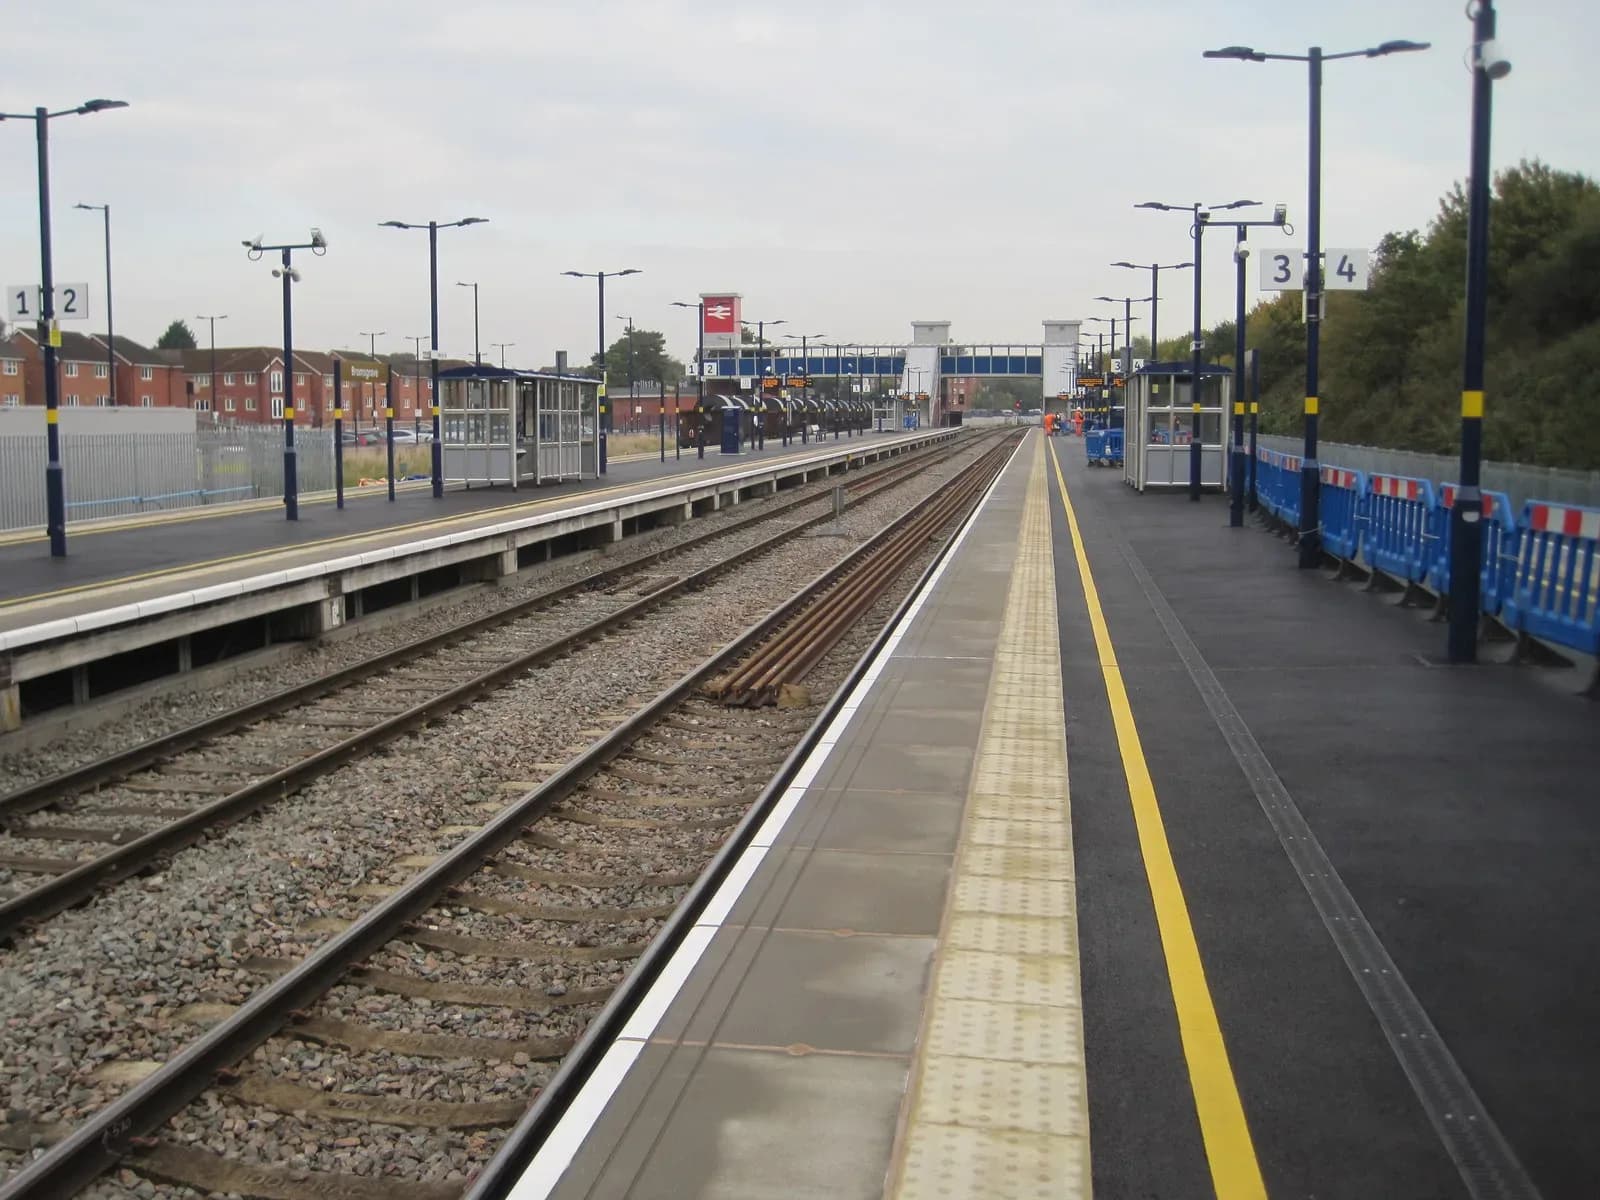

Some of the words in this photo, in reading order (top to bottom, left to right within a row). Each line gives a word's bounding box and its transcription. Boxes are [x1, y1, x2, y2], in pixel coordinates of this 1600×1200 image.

[1273, 254, 1291, 283] 3
[1336, 254, 1356, 283] 4
[16, 290, 29, 314] 1
[63, 288, 77, 313] 2
[689, 364, 694, 374] 1
[707, 364, 713, 374] 2
[1115, 361, 1121, 370] 3
[1135, 361, 1141, 370] 4
